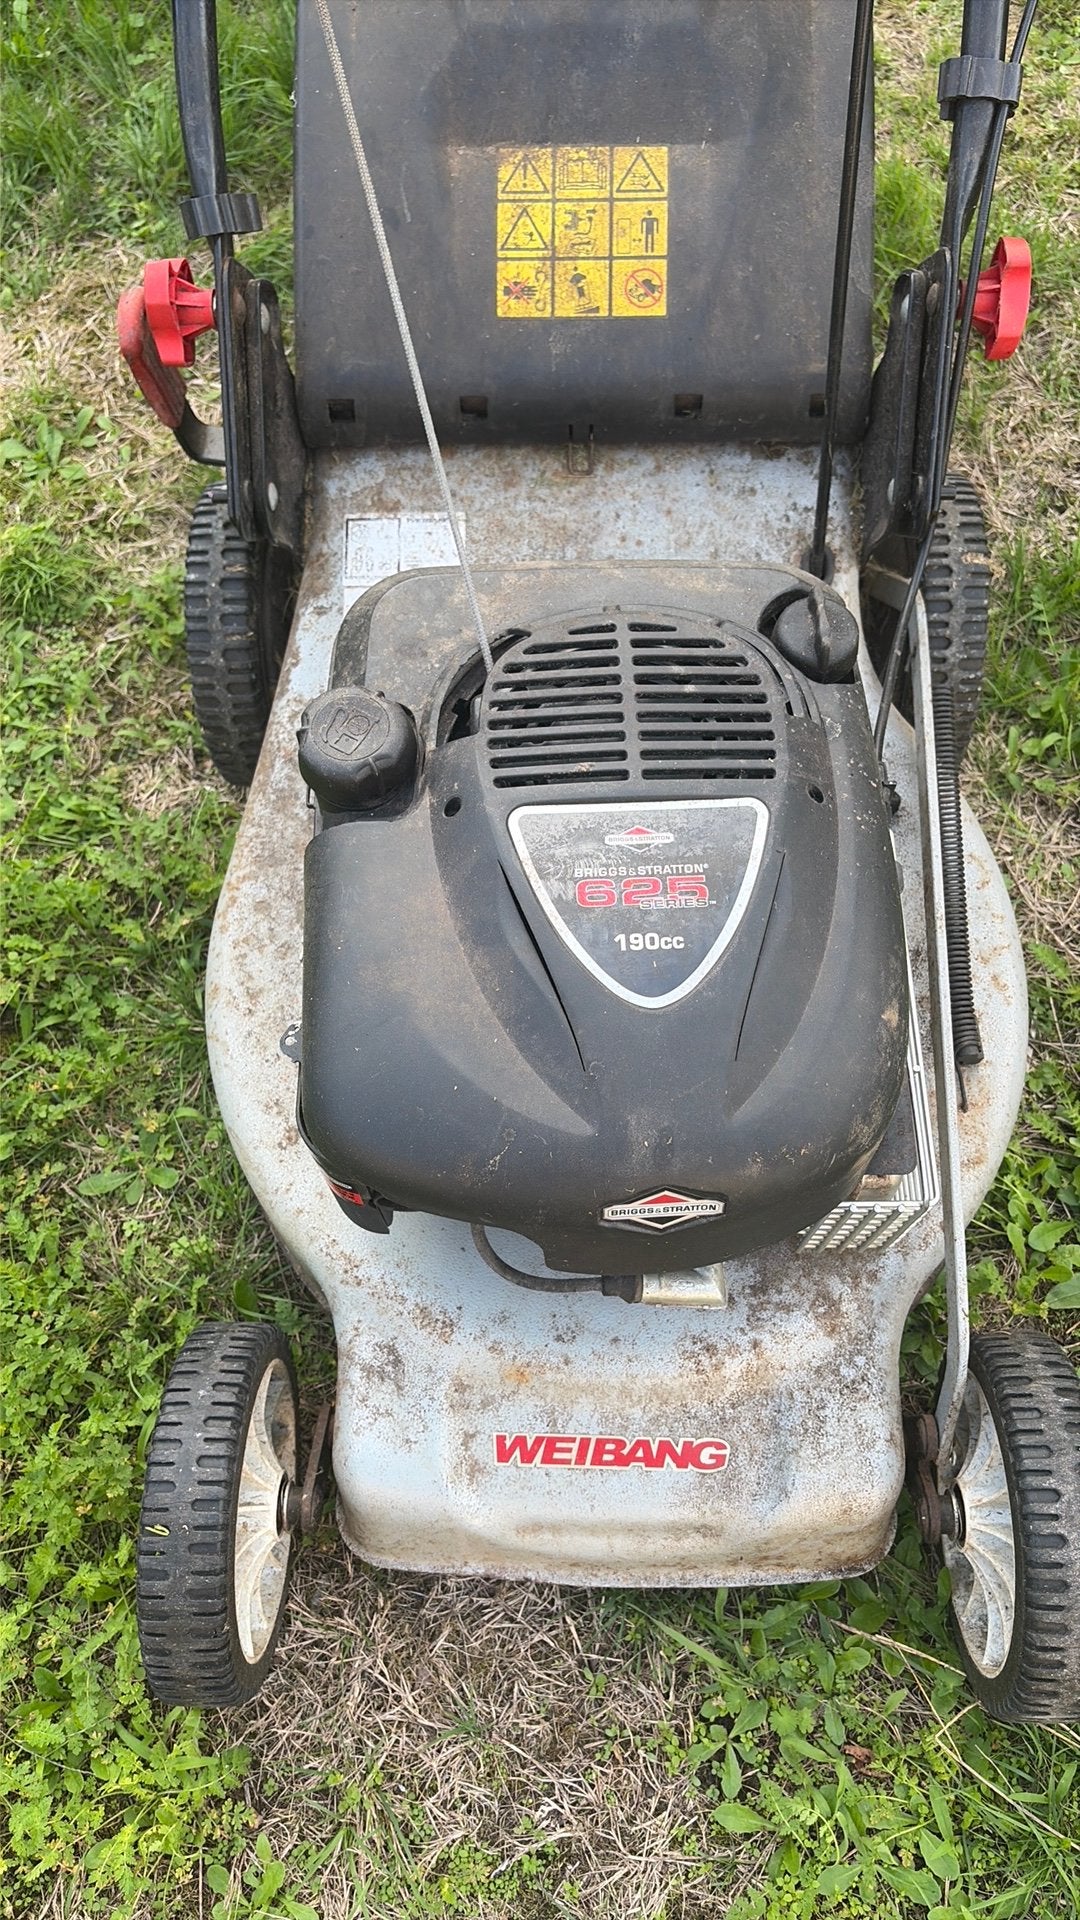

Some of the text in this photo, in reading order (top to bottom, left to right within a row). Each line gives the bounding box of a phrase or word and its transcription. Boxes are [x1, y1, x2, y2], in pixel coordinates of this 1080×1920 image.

[575, 875, 709, 908] 625
[613, 933, 685, 951] 190cc
[494, 1433, 729, 1471] WEIBANG
